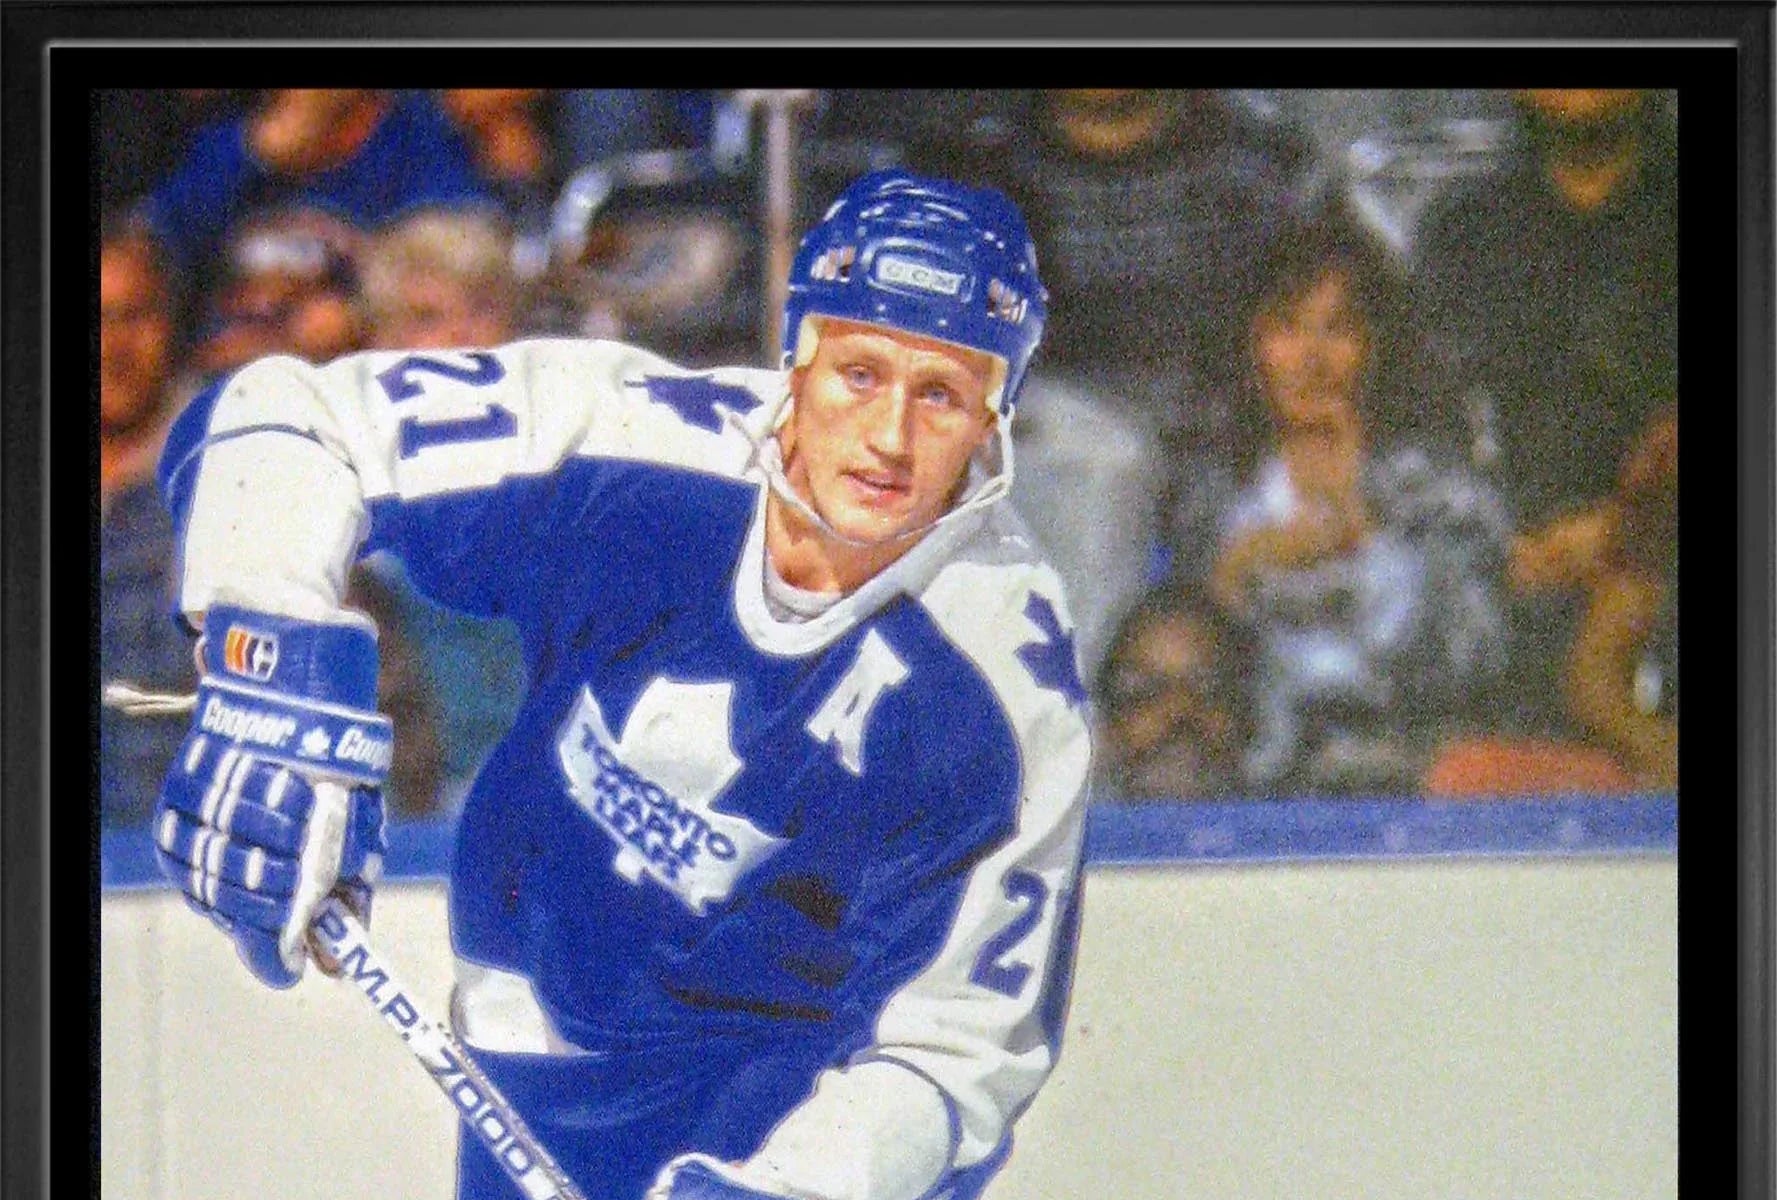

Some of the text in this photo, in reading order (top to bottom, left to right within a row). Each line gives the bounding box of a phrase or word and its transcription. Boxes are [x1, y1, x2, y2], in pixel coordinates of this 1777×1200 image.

[376, 352, 518, 460] 21
[804, 627, 911, 775] A
[581, 722, 738, 862] TORONTO
[968, 864, 1049, 1000] 2
[433, 1046, 533, 1178] 7000
